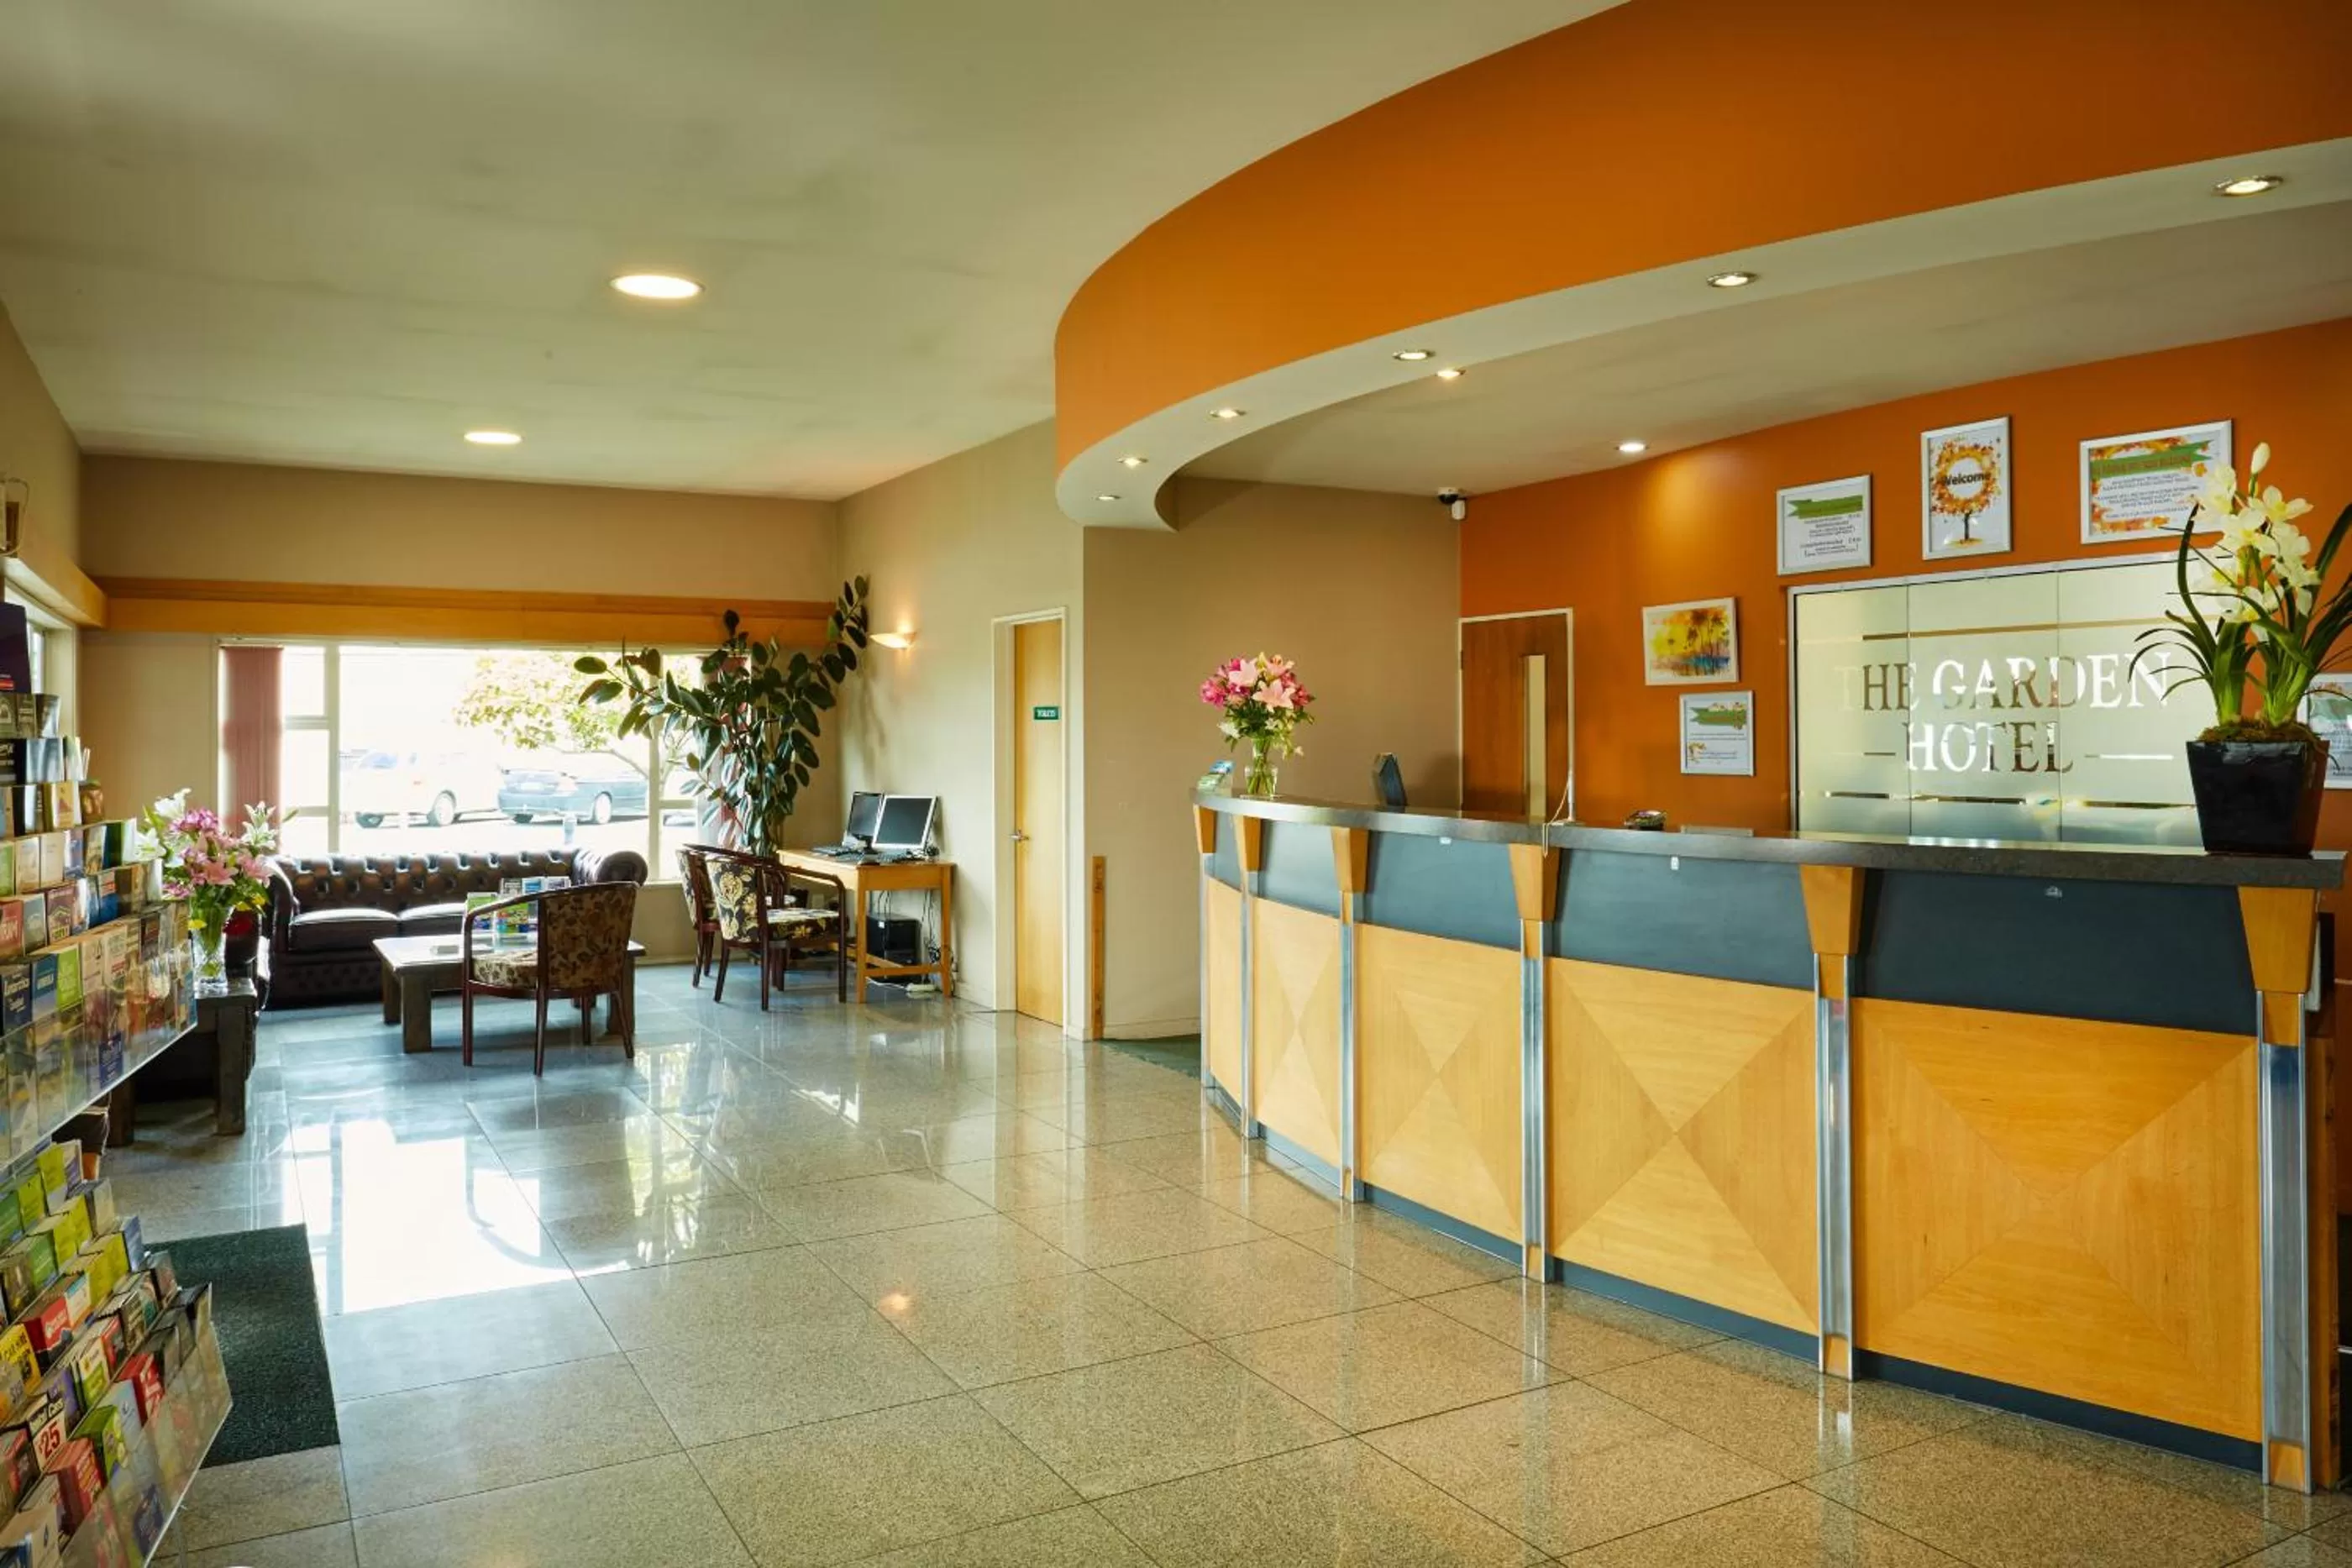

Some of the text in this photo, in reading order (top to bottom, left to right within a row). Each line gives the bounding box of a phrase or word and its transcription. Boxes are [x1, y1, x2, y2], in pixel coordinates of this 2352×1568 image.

[1943, 472, 1991, 485] Welcome
[1835, 652, 2172, 711] THE GARDEN
[1903, 721, 2073, 773] HOTEL
